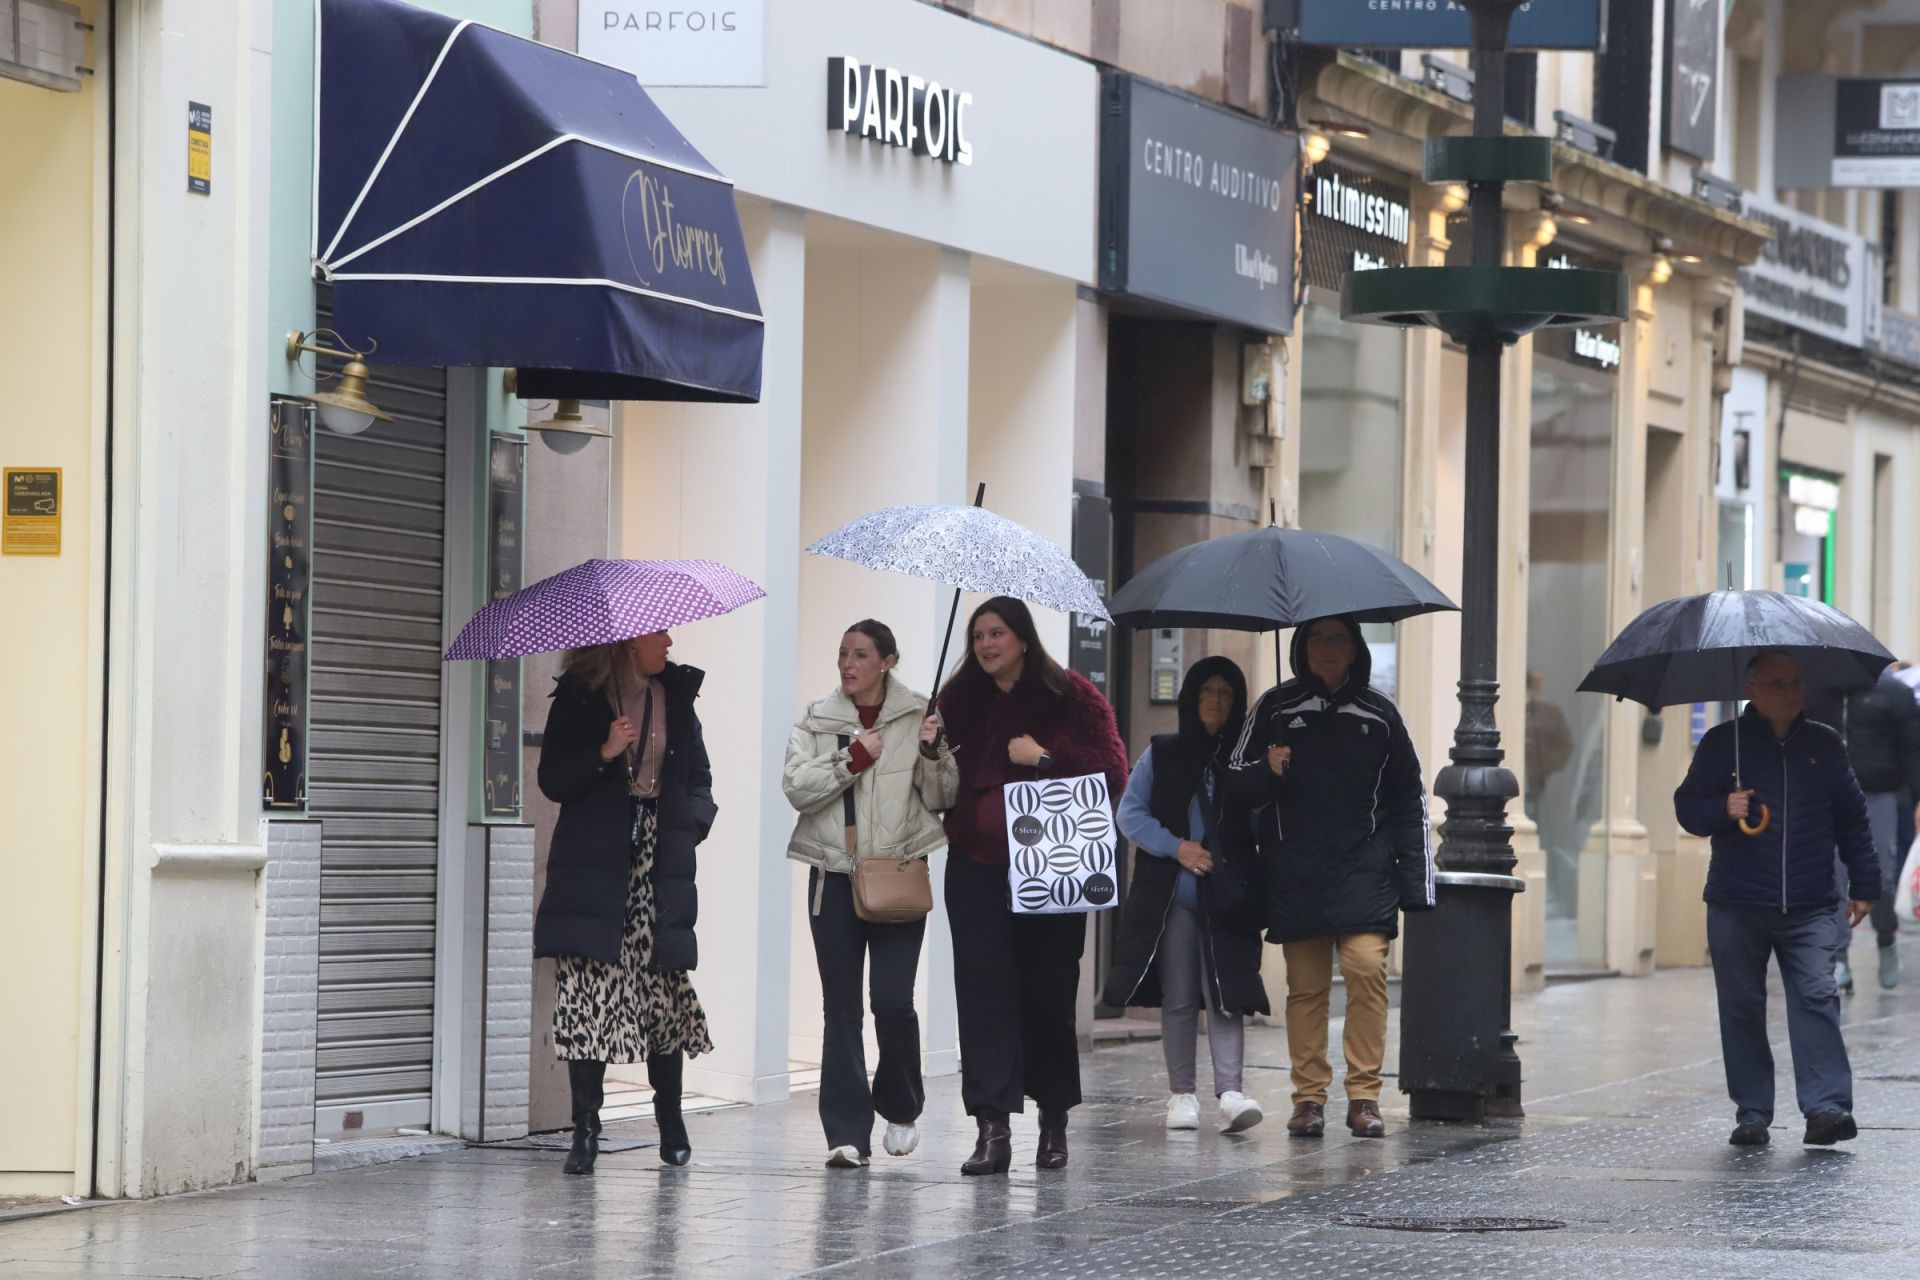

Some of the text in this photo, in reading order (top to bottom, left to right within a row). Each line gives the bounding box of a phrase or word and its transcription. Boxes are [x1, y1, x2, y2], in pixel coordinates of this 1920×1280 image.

[603, 11, 737, 32] PARFOIS
[843, 55, 973, 166] PARFOIS
[1144, 137, 1281, 212] CENTRO AUDITIVO
[1316, 173, 1410, 245] intimissimi
